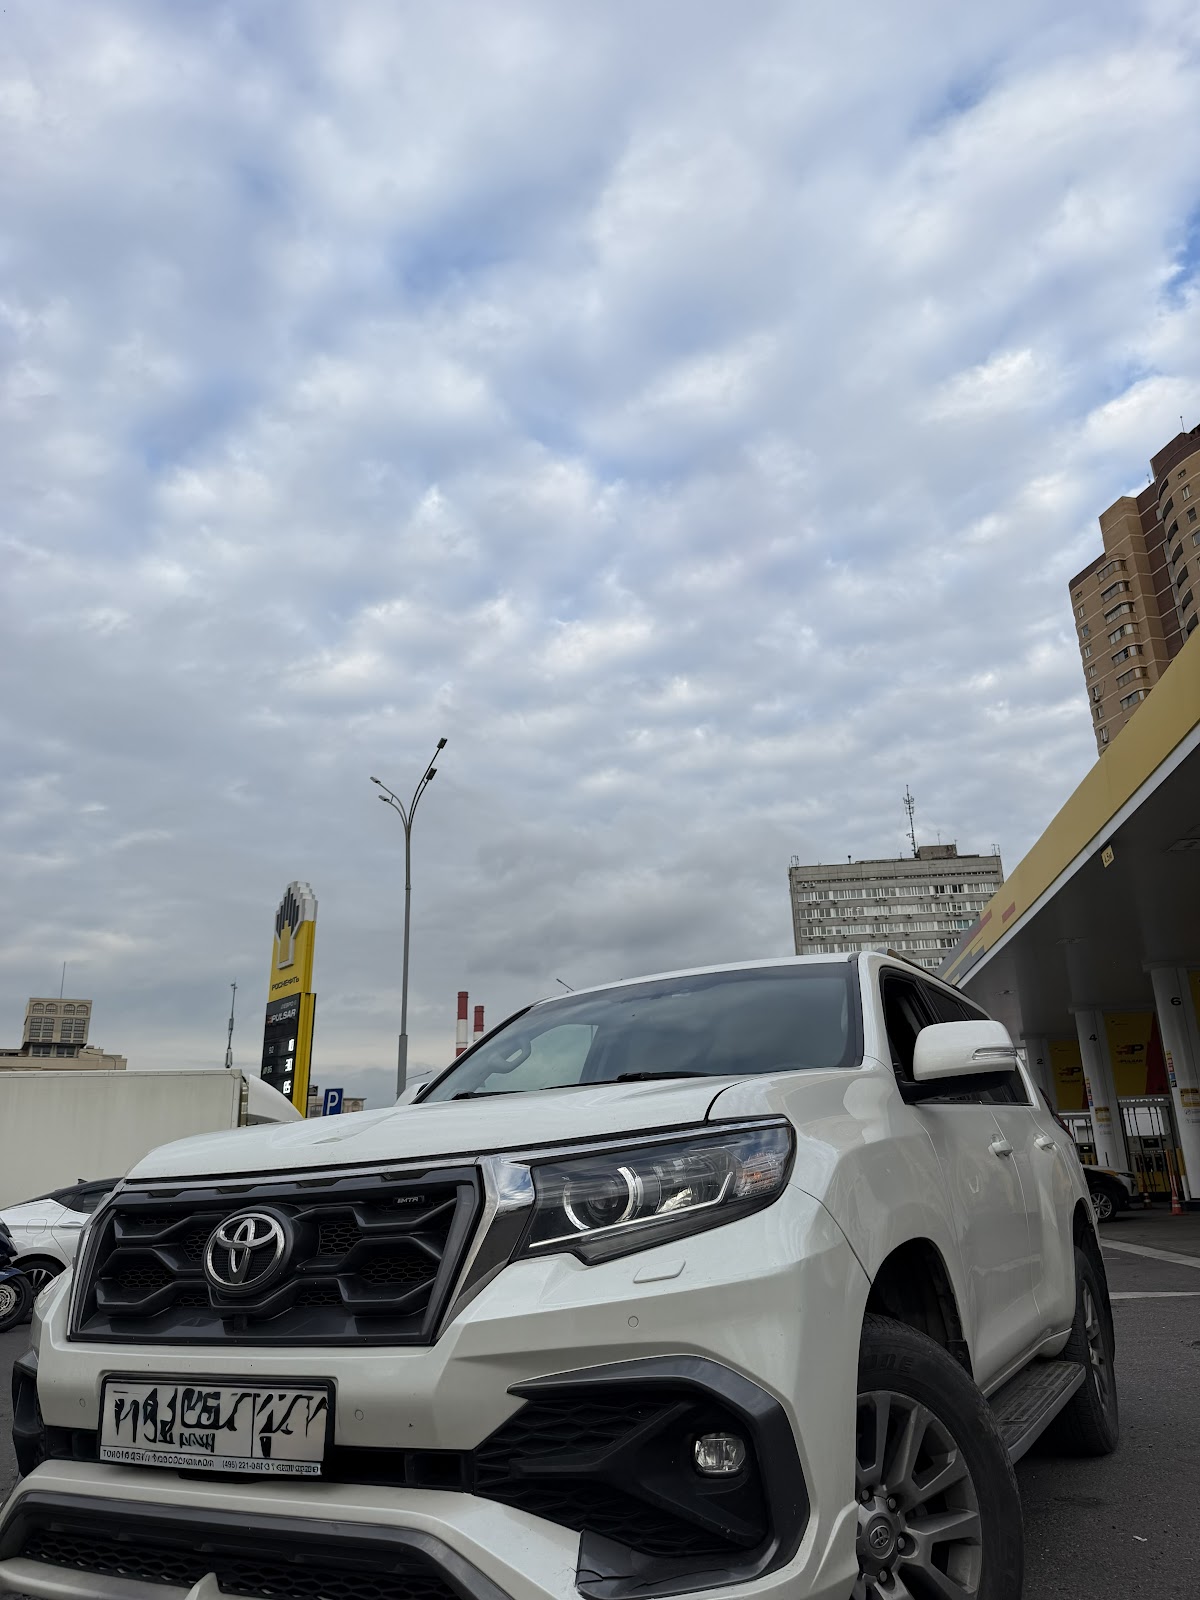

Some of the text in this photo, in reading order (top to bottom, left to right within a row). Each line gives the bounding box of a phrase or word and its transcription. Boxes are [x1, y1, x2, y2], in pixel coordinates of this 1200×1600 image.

[271, 976, 300, 991] РОСНЕФТЬ
[1170, 997, 1182, 1006] 6
[271, 1008, 297, 1022] PULSAR
[1089, 1034, 1098, 1042] 4
[326, 1091, 339, 1115] P
